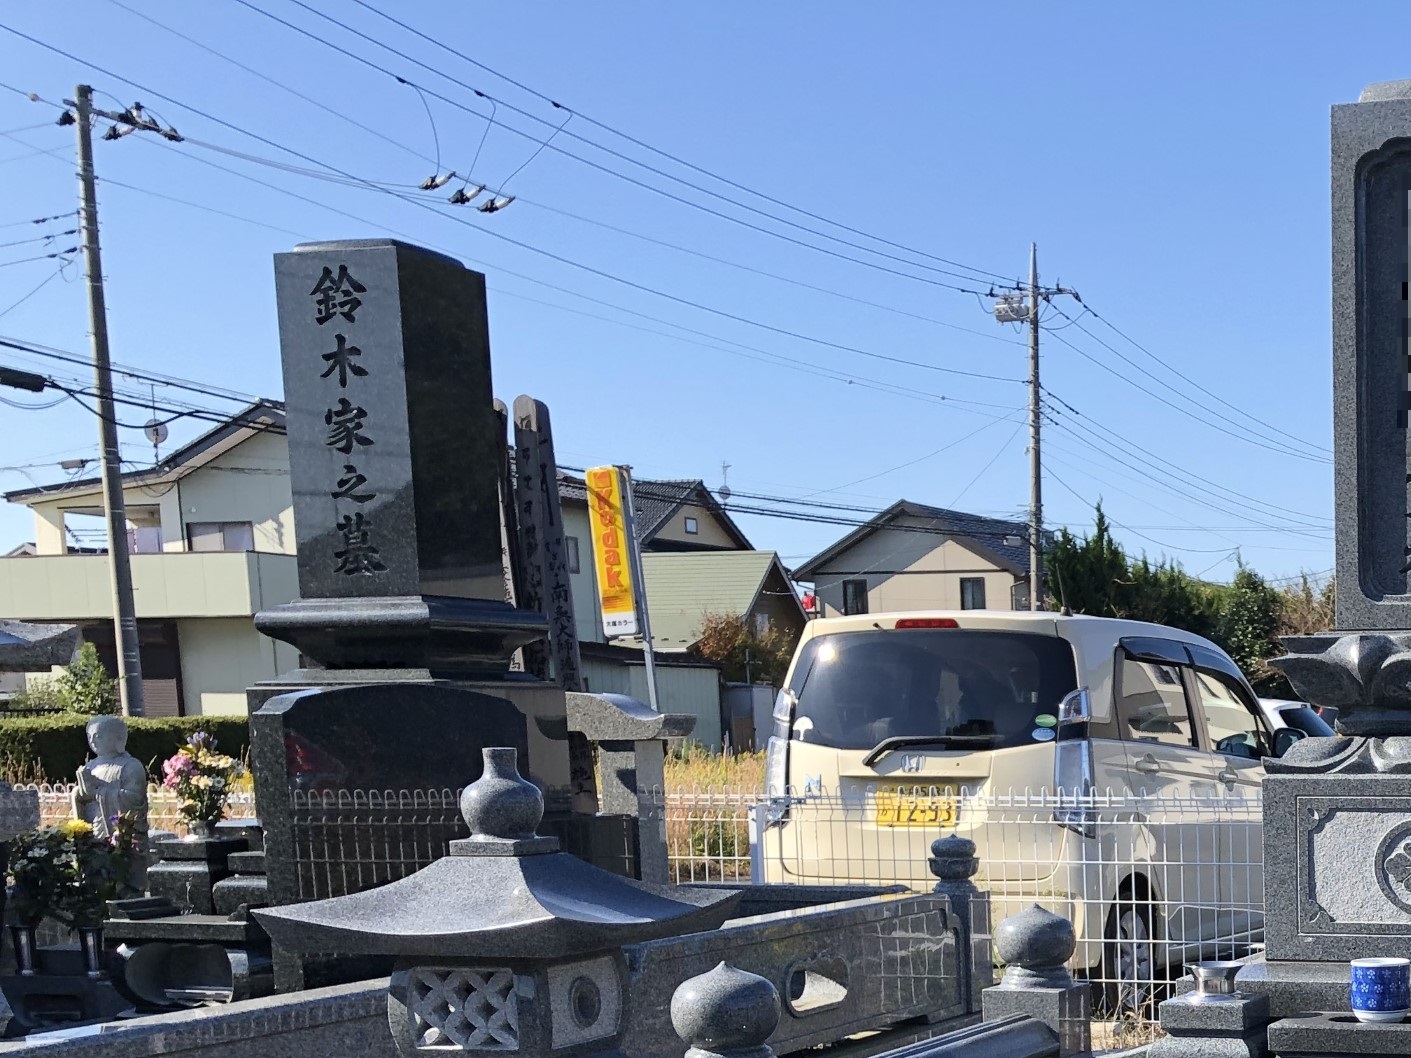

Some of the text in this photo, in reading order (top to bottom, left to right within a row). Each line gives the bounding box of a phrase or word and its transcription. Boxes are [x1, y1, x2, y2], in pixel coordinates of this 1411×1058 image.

[308, 263, 389, 578] 鈴木家之墓
[594, 487, 625, 589] Kodak
